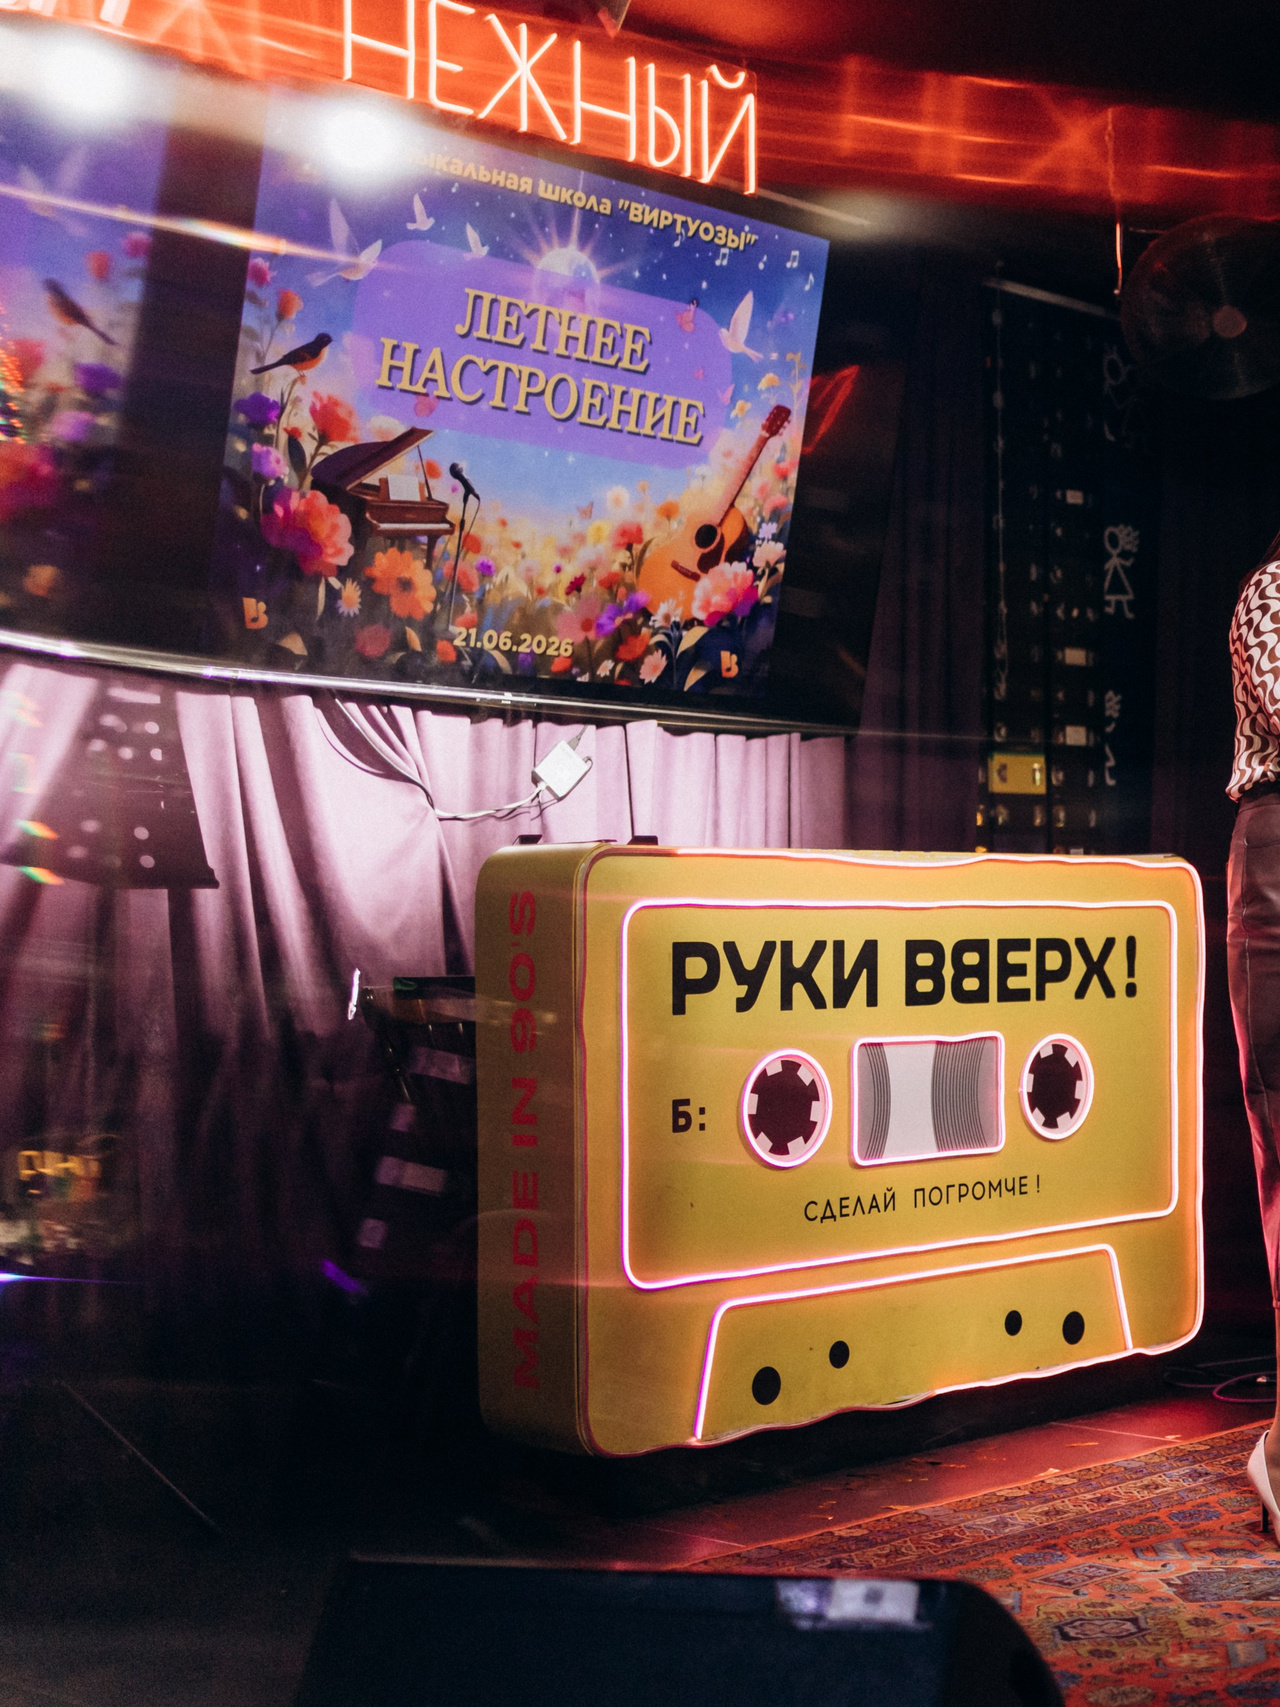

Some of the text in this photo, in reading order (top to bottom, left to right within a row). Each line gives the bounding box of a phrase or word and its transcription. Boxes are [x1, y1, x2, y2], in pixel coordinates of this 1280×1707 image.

[342, 0, 758, 195] НЕЖНЫЙ
[618, 199, 758, 250] "ВИРТУОЗЫ"
[454, 287, 652, 373] ЛЕТНЕЕ
[374, 337, 705, 445] НАСТРОЕНИЕ
[452, 626, 574, 657] 21.06.2026
[671, 935, 1138, 1016] РУКИ ВВЕРХ!
[508, 890, 540, 1389] MADE IN 90'S
[671, 1098, 707, 1134] Б:
[803, 1187, 897, 1224] СДЕЛАЙ
